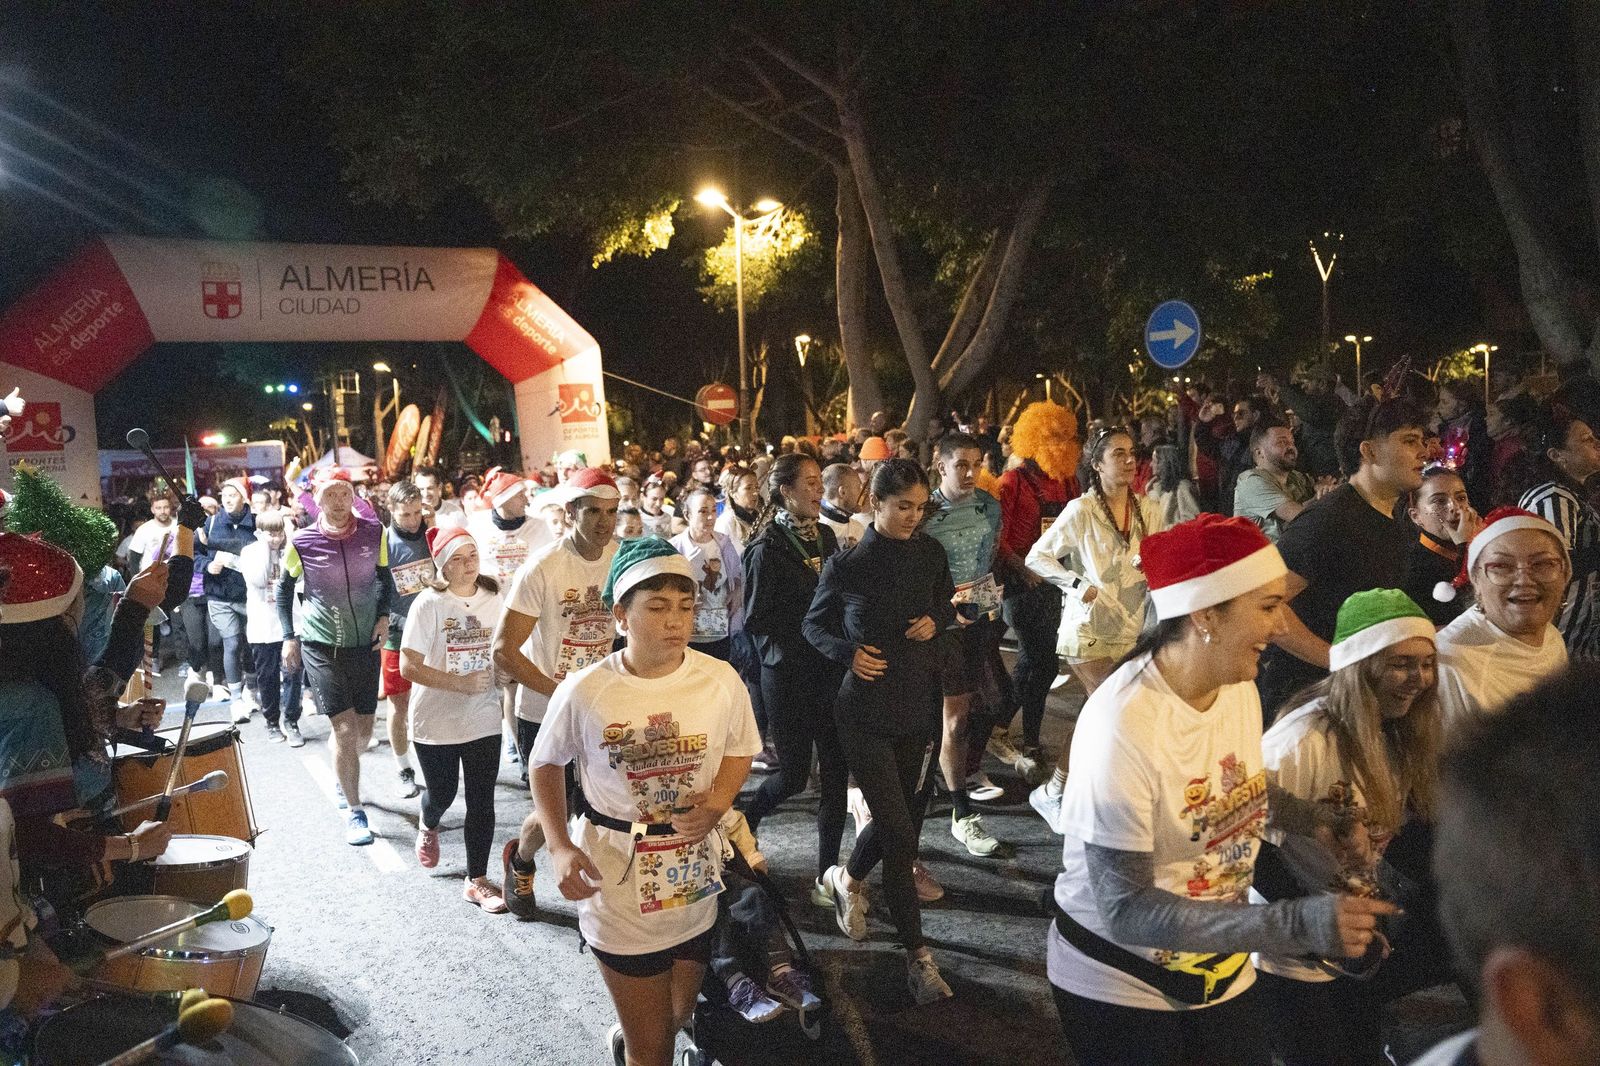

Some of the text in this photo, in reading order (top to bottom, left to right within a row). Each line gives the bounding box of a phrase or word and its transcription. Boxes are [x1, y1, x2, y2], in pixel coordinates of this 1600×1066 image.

[279, 261, 436, 291] ALMERÍA
[278, 298, 361, 315] CIUDAD
[69, 302, 123, 350] deporte
[512, 315, 557, 355] deporte
[463, 660, 484, 670] 972
[644, 720, 680, 741] SAN
[621, 733, 707, 762] SILVESTRE
[626, 759, 658, 771] Ciudad
[660, 758, 672, 767] de
[666, 861, 702, 884] 975
